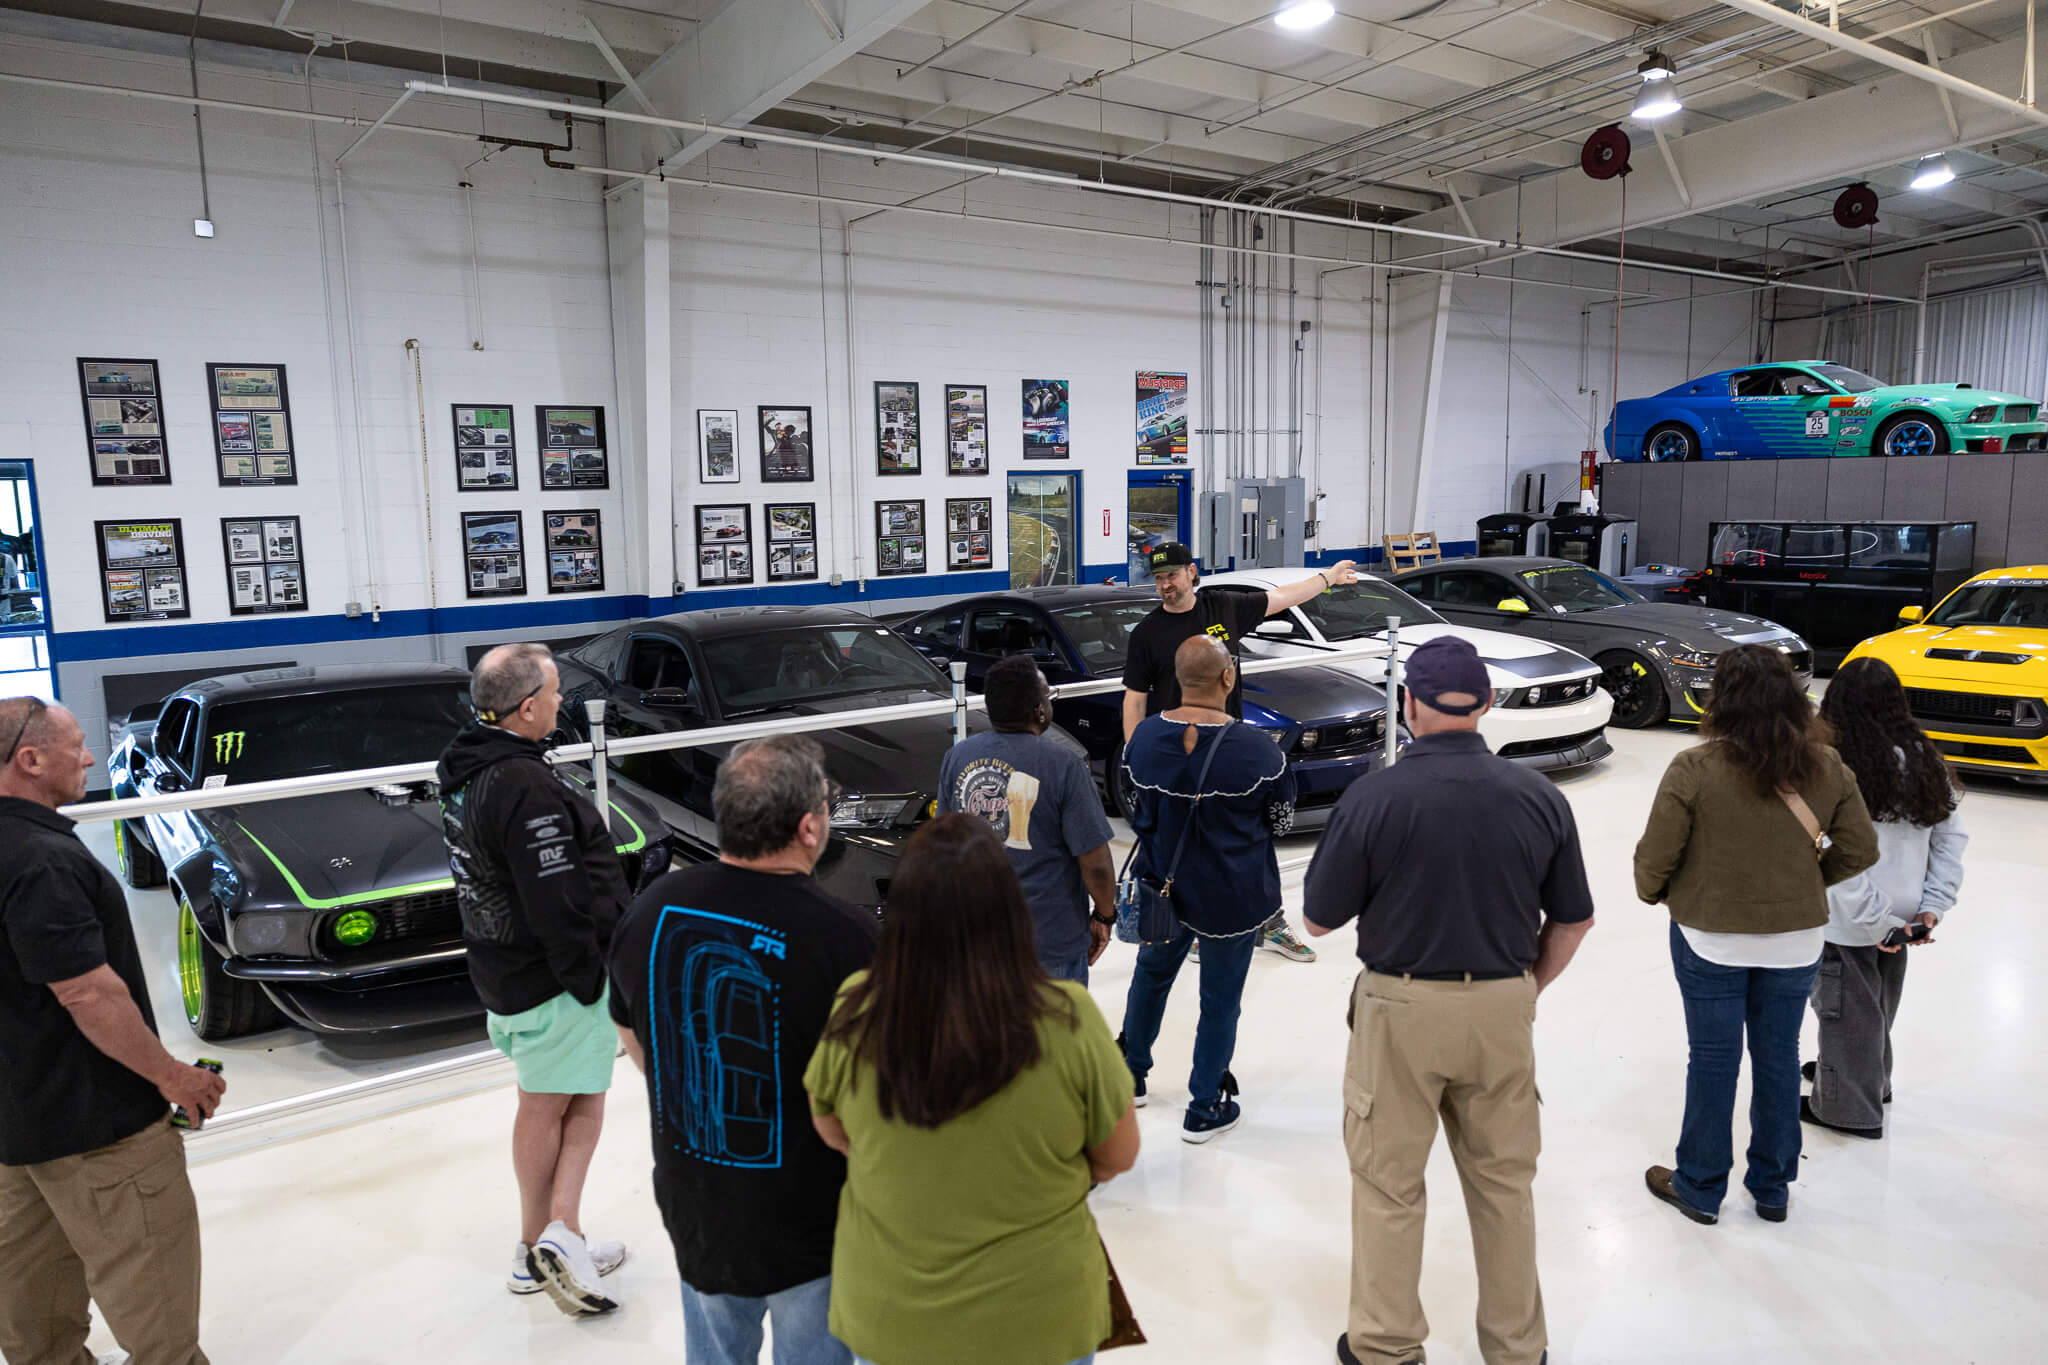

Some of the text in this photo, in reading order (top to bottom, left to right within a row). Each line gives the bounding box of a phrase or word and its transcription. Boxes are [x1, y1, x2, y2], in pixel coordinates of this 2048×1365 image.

[1138, 377, 1186, 390] Mustangs
[1137, 392, 1169, 410] DRIFT
[1139, 403, 1166, 420] KING
[1811, 417, 1823, 430] 25
[749, 934, 788, 960] RTR
